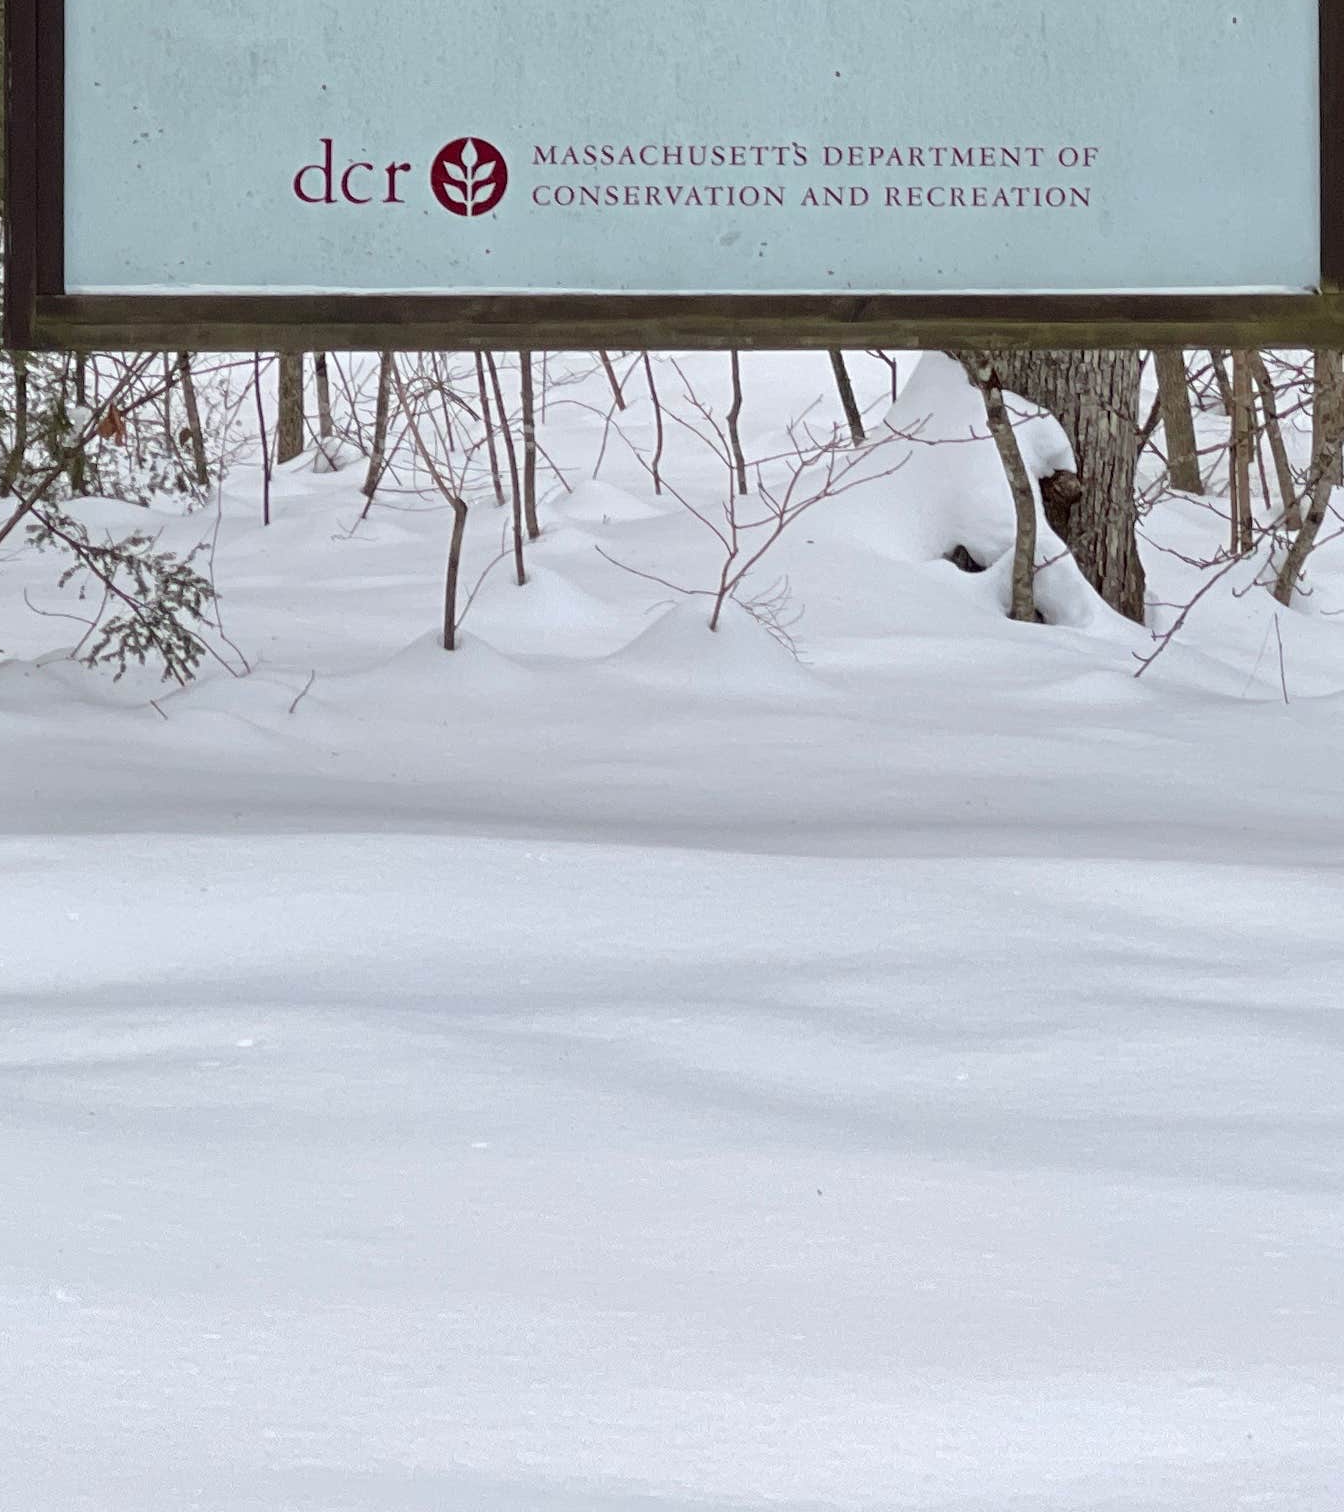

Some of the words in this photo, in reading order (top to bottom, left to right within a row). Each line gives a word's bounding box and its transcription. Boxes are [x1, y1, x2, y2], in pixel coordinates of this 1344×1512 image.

[532, 144, 808, 168] MASSACHUSETTS
[823, 145, 1045, 168] DEPARTMENT
[1057, 145, 1100, 168] OF
[293, 138, 412, 204] dcr
[532, 185, 786, 207] CONSERVATION
[800, 186, 870, 207] AND
[884, 186, 1093, 208] RECREATION
